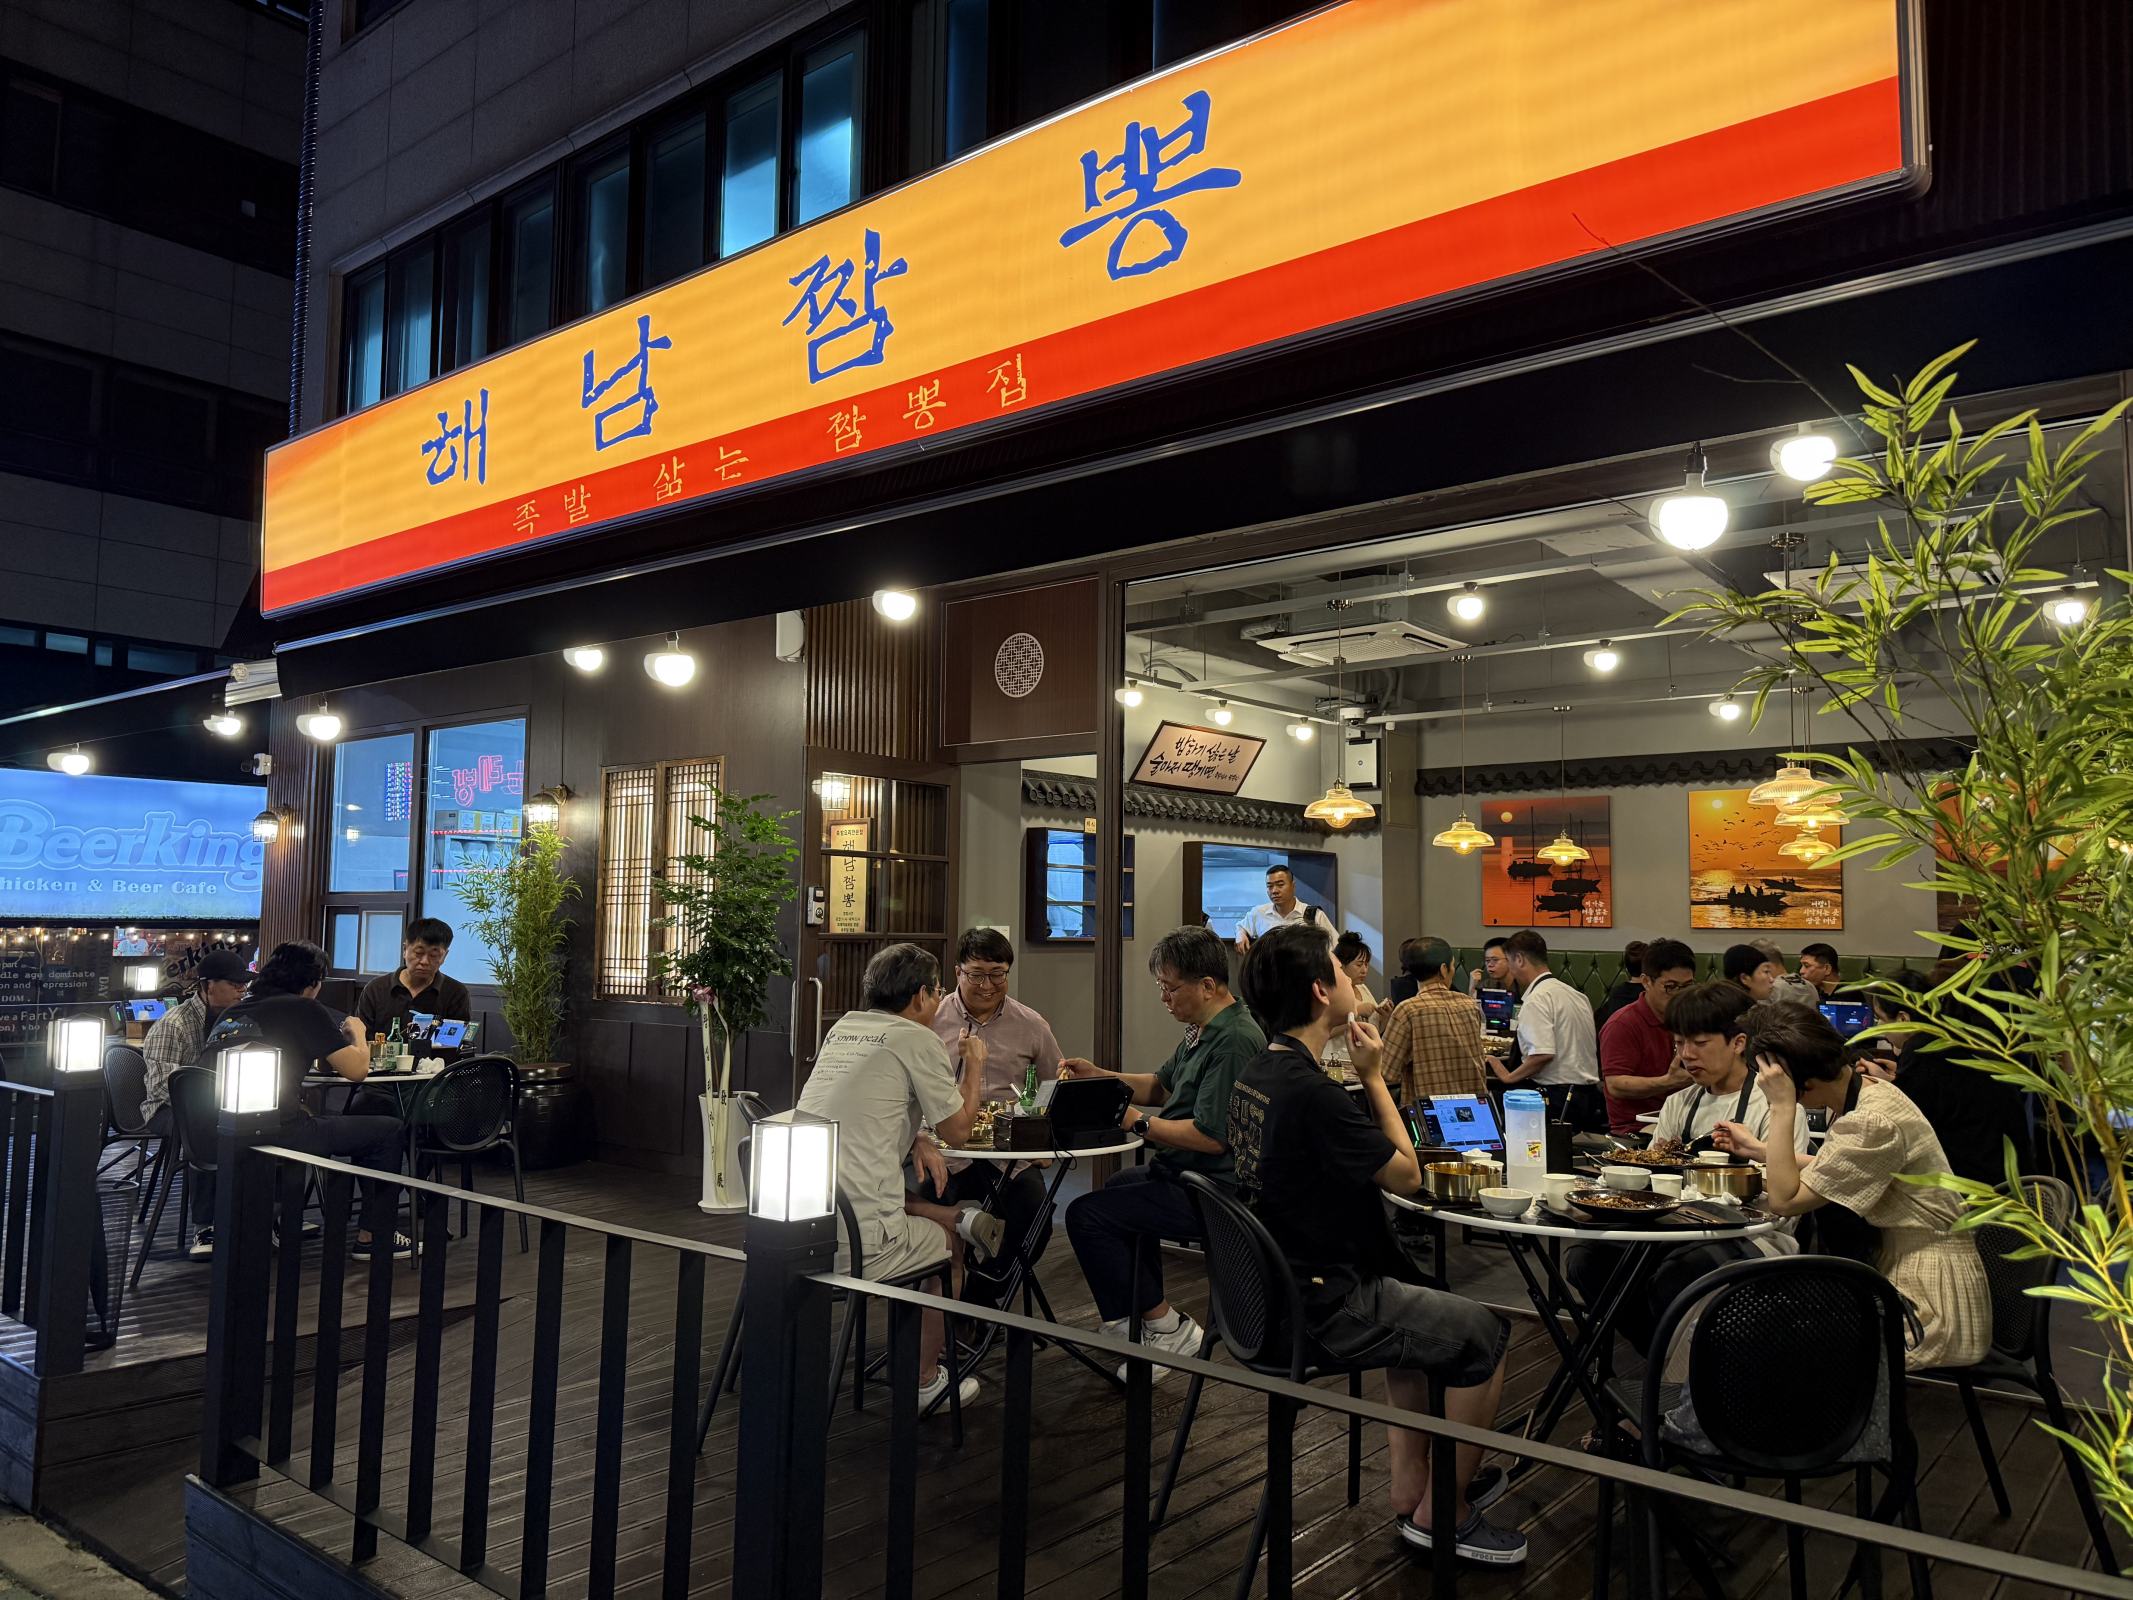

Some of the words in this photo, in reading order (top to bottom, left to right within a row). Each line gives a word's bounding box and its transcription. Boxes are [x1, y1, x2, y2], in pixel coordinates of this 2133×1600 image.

[0, 804, 264, 888] Beerking
[88, 879, 103, 893] &
[112, 879, 162, 894] Beer
[172, 881, 217, 895] Cafe
[48, 970, 95, 979] dominate
[13, 981, 31, 989] and
[858, 1032, 888, 1045] peak
